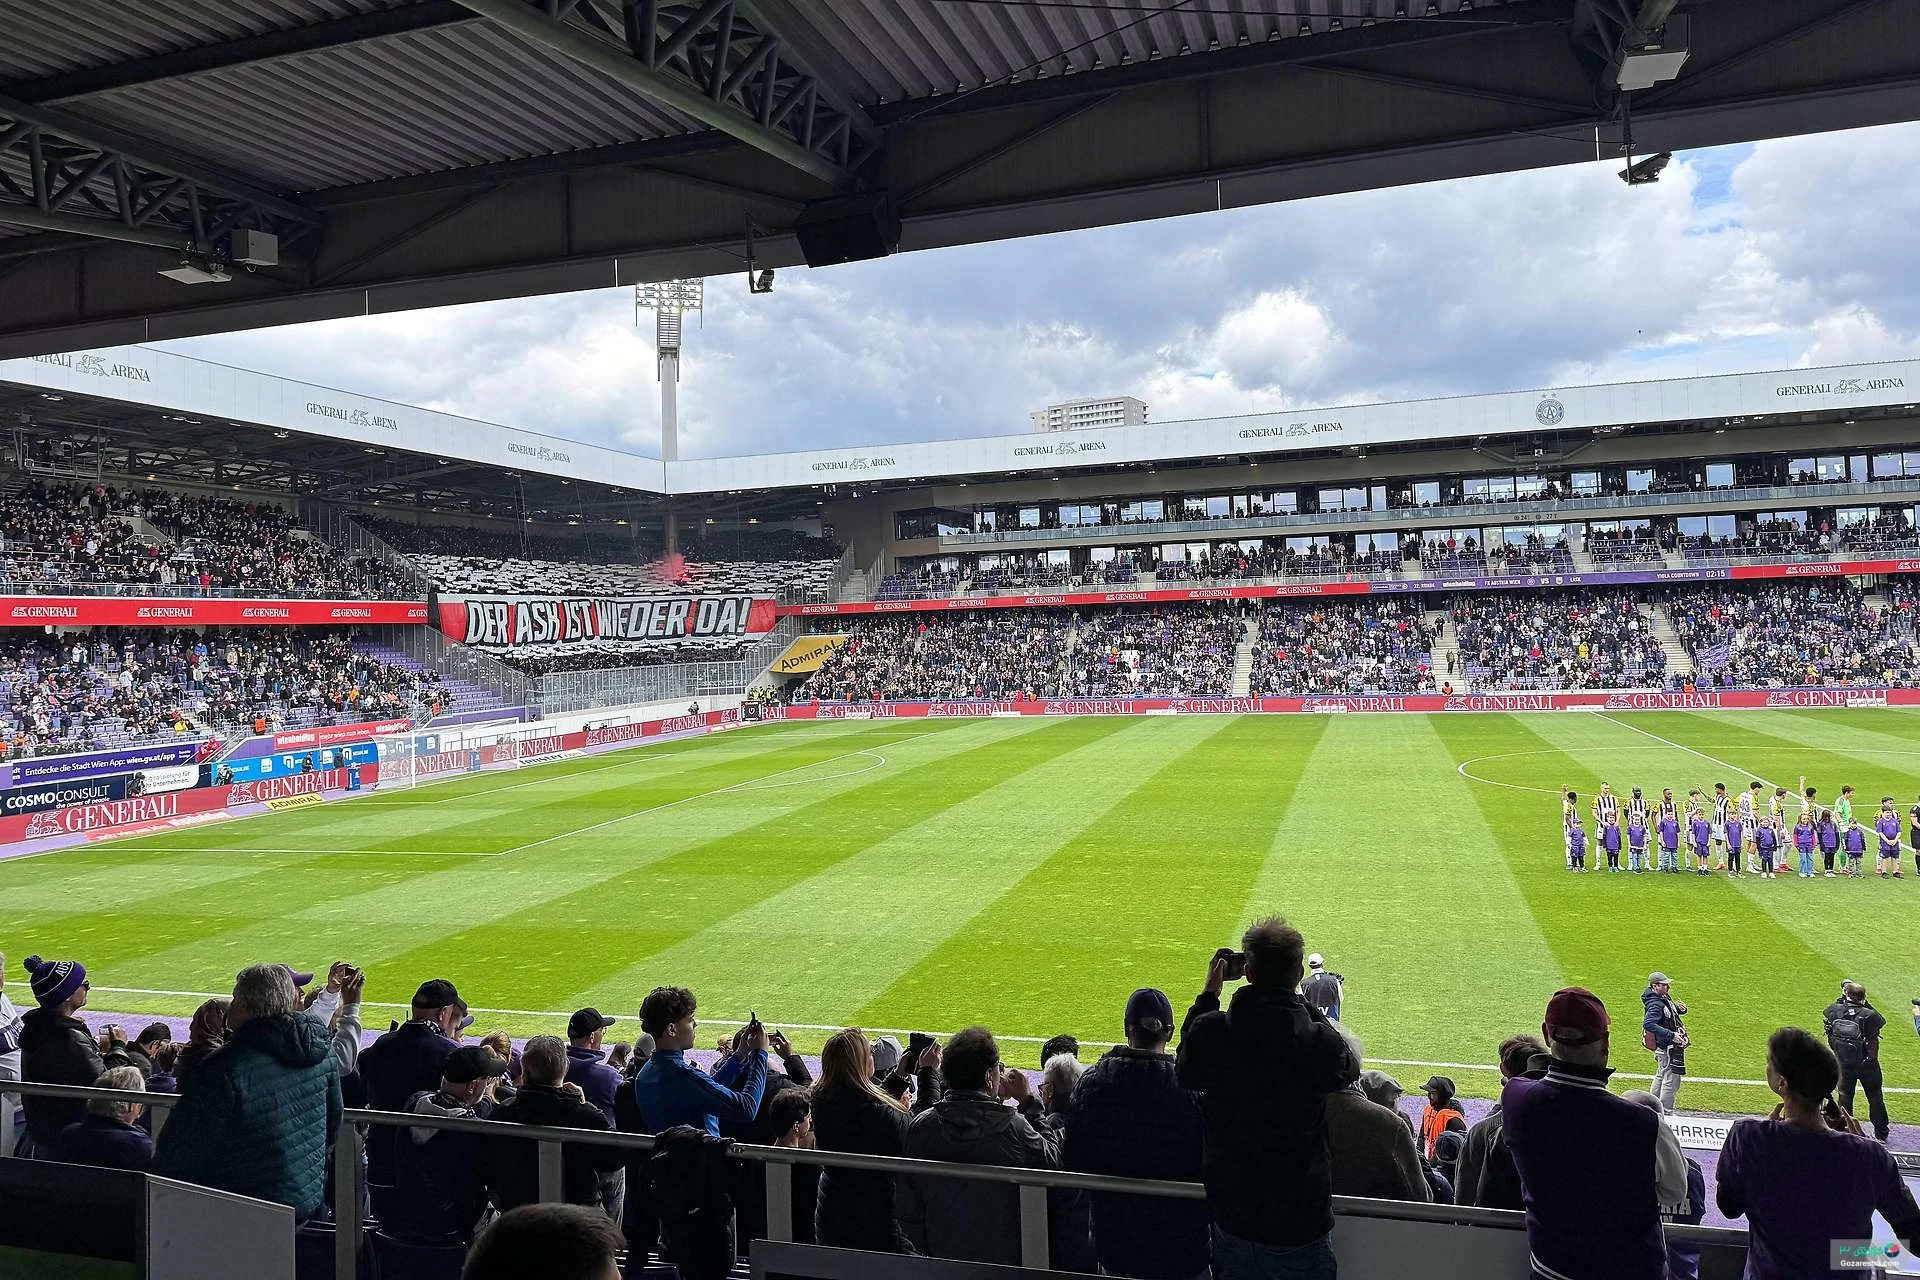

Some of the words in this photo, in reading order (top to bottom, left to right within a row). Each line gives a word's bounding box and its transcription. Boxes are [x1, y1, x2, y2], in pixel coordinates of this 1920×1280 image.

[111, 364, 150, 382] ARENA
[1776, 384, 1831, 396] GENERALI
[1866, 378, 1904, 390] ARENA
[306, 402, 347, 420] GENERALI
[371, 415, 398, 430] ARENA
[1239, 427, 1283, 438] GENERALI
[1311, 422, 1343, 432] ARENA
[508, 442, 536, 456] GENERALI
[553, 452, 571, 463] ARENA
[1014, 445, 1053, 456] GENERALI
[1078, 441, 1106, 452] ARENA
[812, 461, 848, 471] GENERALI
[870, 457, 896, 467] ARENA
[1706, 569, 1726, 578] 02:15
[1799, 565, 1841, 574] GENERALI
[1540, 577, 1550, 585] VS
[1115, 592, 1147, 601] GENERALI
[1200, 589, 1233, 597] GENERALI
[1288, 586, 1322, 594] GENERALI
[882, 602, 912, 610] GENERALI
[958, 599, 987, 607] GENERALI
[1034, 595, 1065, 604] GENERALI
[28, 607, 78, 617] GENERALI
[151, 607, 193, 618] GENERALI
[254, 608, 289, 617] GENERALI
[341, 608, 372, 617] GENERALI
[810, 605, 838, 613] GENERALI
[465, 600, 508, 645] DER
[561, 599, 595, 642] IST
[595, 599, 690, 640] WIEDER
[694, 598, 752, 637] DA!
[781, 639, 842, 672] ADMIRAL
[1190, 698, 1264, 712] GENERALI
[1470, 695, 1554, 710] GENERALI
[1634, 692, 1722, 708] GENERALI
[948, 702, 1012, 716] GENERALI
[1065, 701, 1134, 714] GENERALI
[673, 713, 707, 731] GENERALI
[277, 733, 315, 745] wienholding
[600, 723, 643, 744] GENERALI
[25, 765, 59, 776] Entdecke
[60, 762, 71, 773] die
[72, 760, 91, 771] Stadt
[91, 759, 109, 770] Wien
[109, 758, 126, 770] App:
[256, 770, 340, 800] GENERALI
[6, 785, 110, 810] COSMOCONSULT
[270, 795, 319, 810] ADMIRAL
[66, 793, 179, 832] GENERALI
